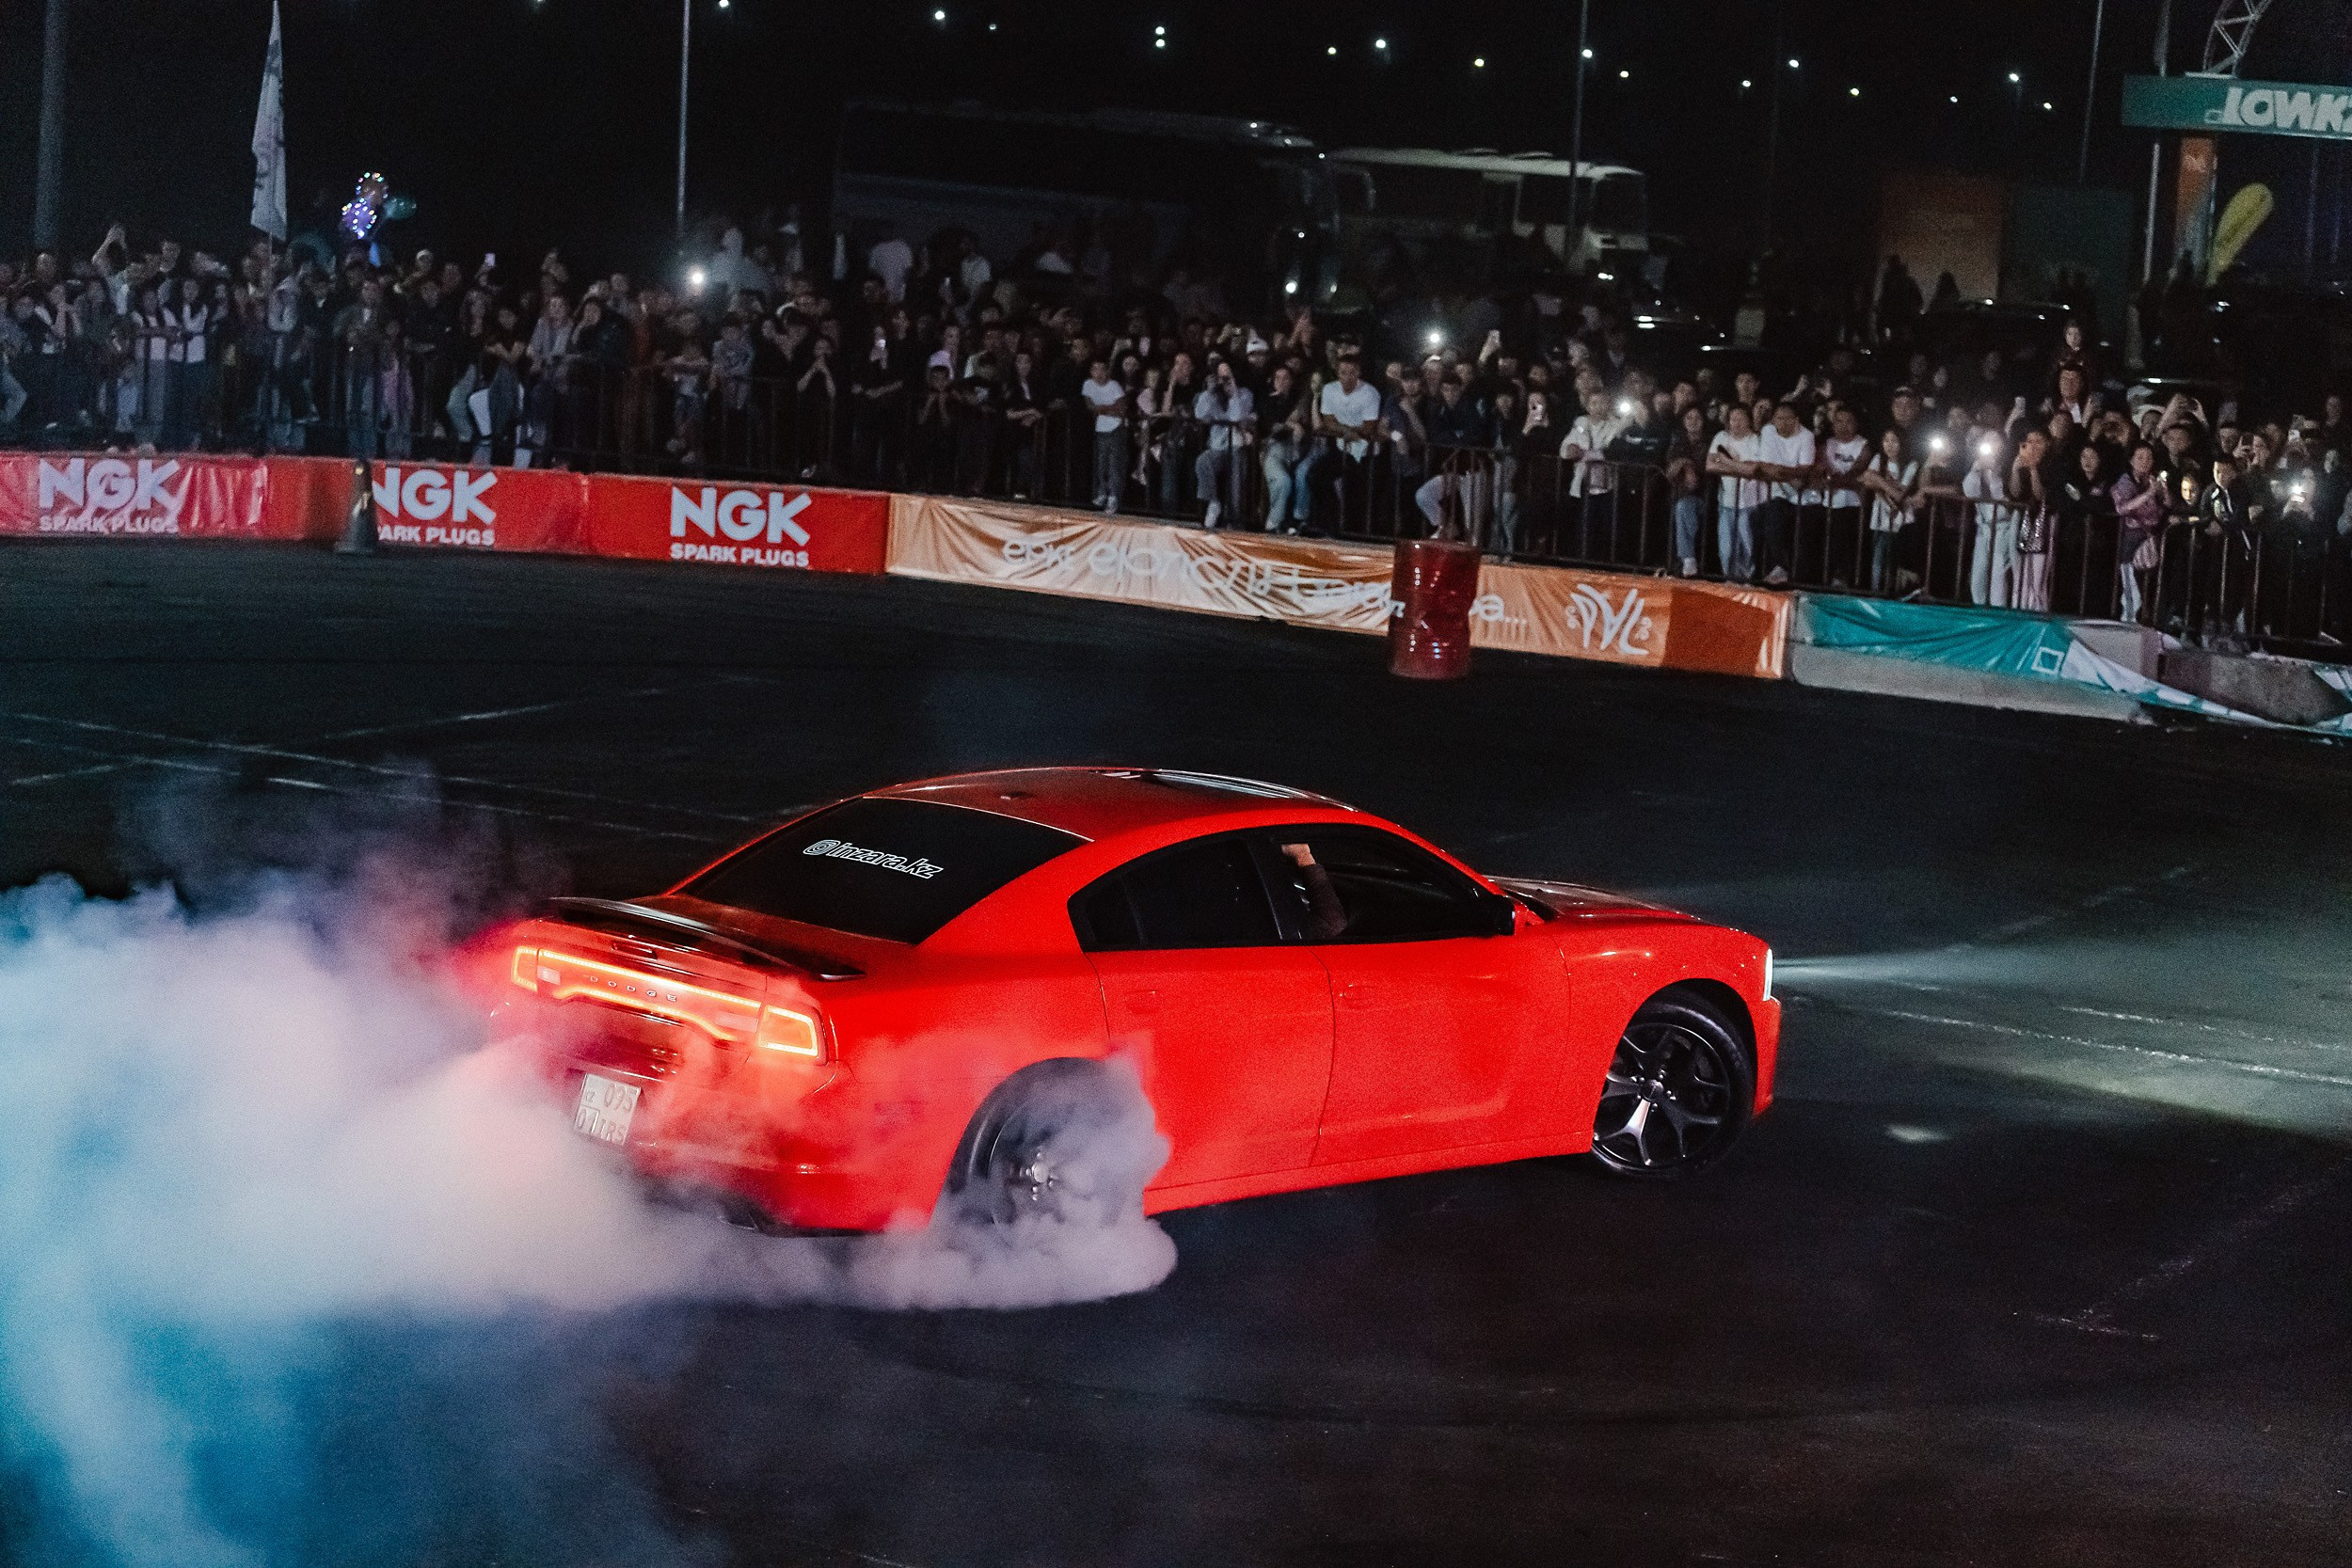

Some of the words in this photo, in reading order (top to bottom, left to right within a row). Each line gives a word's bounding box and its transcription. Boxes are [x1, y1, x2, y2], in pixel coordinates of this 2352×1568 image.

[40, 458, 180, 513] NGK
[372, 467, 498, 525] NGK
[40, 515, 108, 534] SPARK
[670, 486, 812, 546] NGK
[377, 524, 422, 543] ARK
[425, 527, 496, 546] PLUGS
[670, 542, 737, 562] SPARK
[740, 547, 810, 568] PLUGS
[803, 839, 944, 879] @inzara.kz
[590, 975, 676, 1002] DODGE
